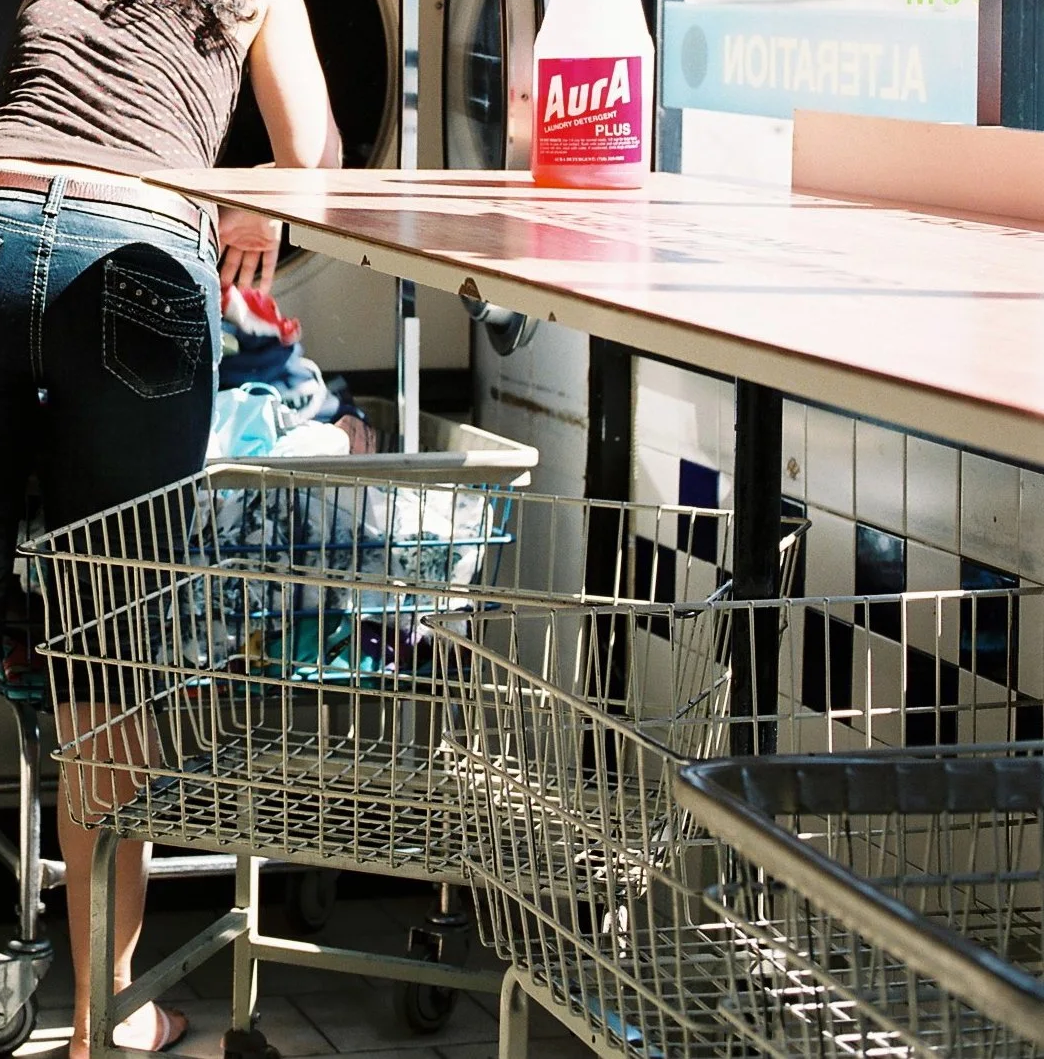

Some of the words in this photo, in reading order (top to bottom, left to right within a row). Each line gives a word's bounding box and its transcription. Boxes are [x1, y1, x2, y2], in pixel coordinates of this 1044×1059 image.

[544, 120, 573, 134] LAUNDRY
[573, 110, 618, 127] DETERGENT
[595, 123, 632, 137] PLUS
